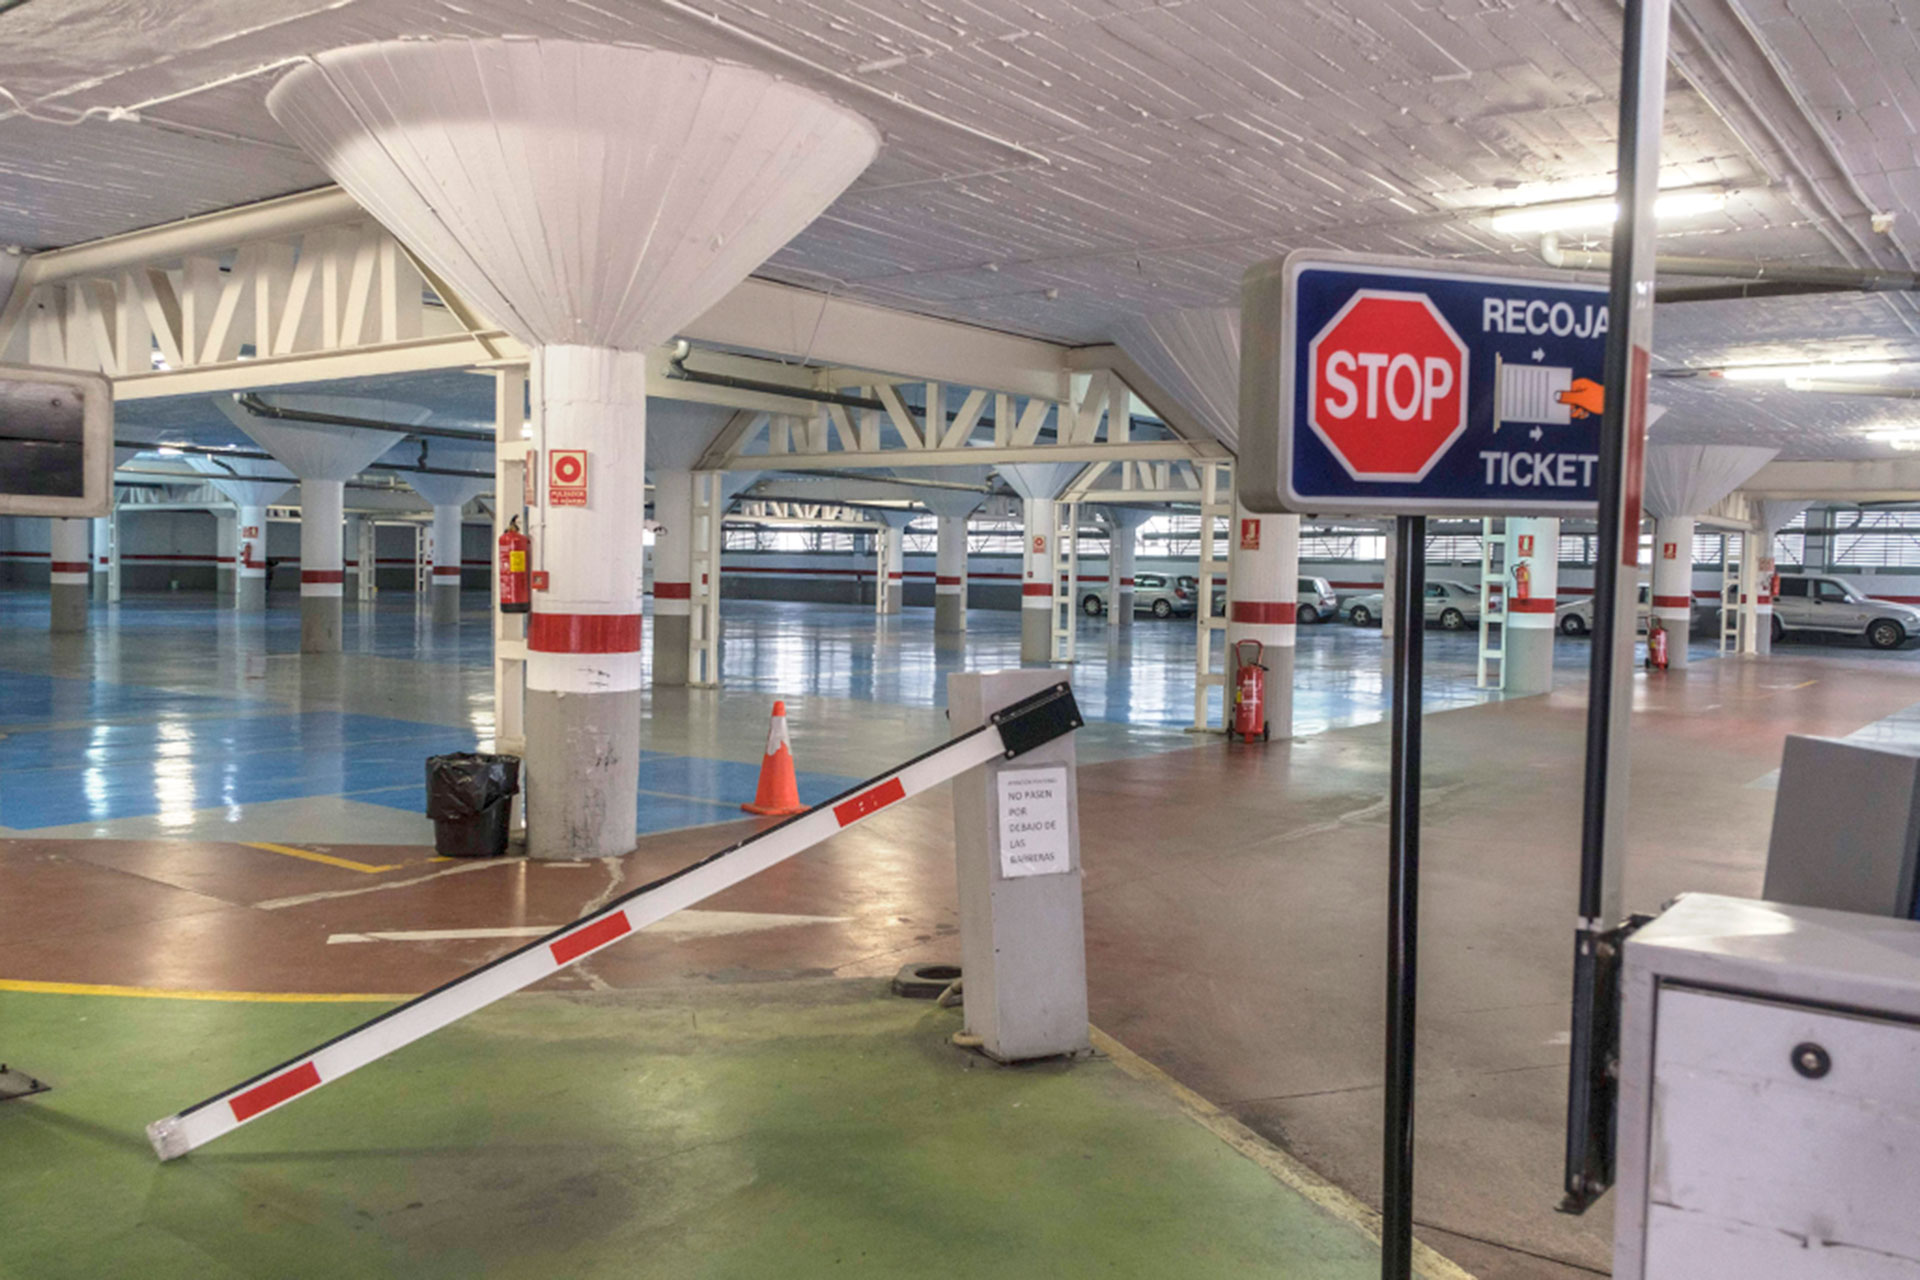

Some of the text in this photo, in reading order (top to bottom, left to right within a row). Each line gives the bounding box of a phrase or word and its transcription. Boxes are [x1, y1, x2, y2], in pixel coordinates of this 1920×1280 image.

[1482, 297, 1609, 338] RECOJA
[1324, 350, 1453, 421] STOP
[1479, 451, 1599, 487] TICKET
[1008, 789, 1052, 801] NO PASEN
[1009, 807, 1027, 817] POR
[1009, 820, 1057, 832] DEBAJO DE
[1010, 839, 1026, 849] LAS
